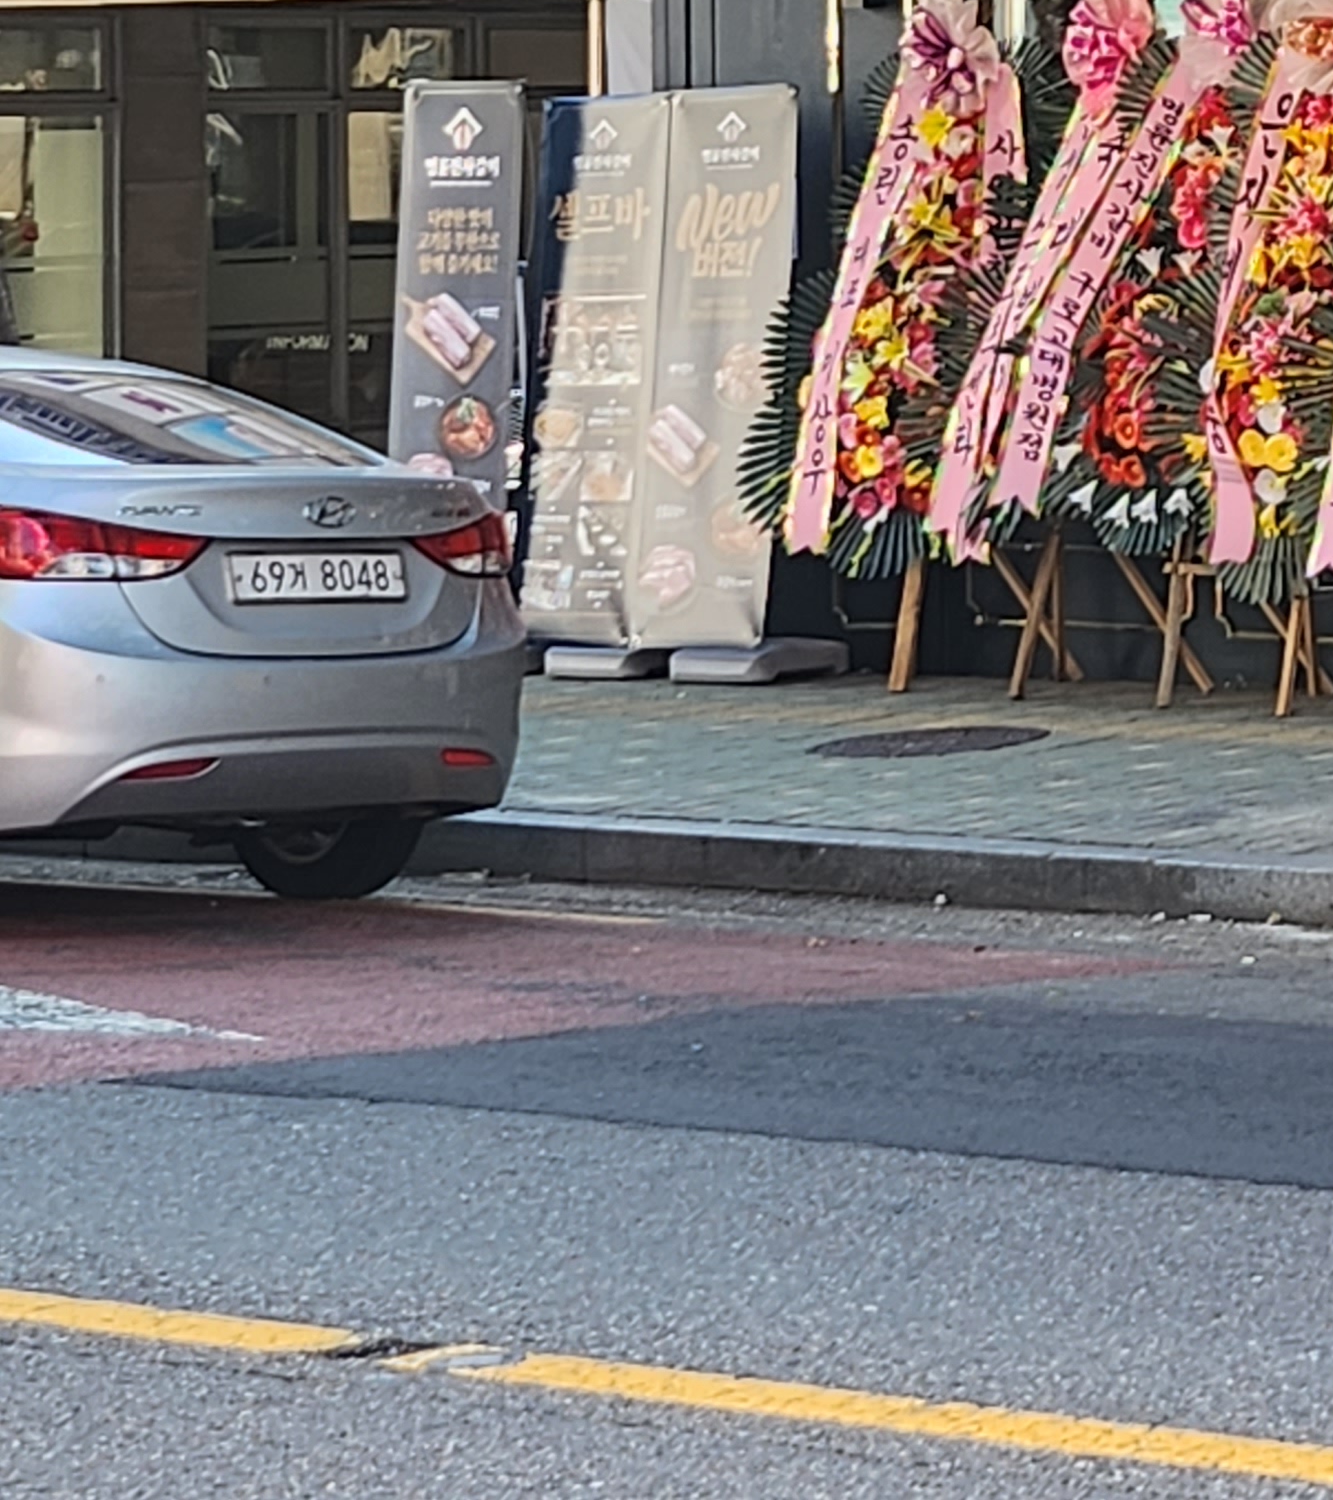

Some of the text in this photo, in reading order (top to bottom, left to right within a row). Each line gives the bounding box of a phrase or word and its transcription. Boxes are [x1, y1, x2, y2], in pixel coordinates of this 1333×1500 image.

[548, 186, 651, 241] 셀프바
[676, 182, 780, 252] New
[1017, 271, 1097, 462] 구로고대병원점
[319, 559, 390, 592] 8048
